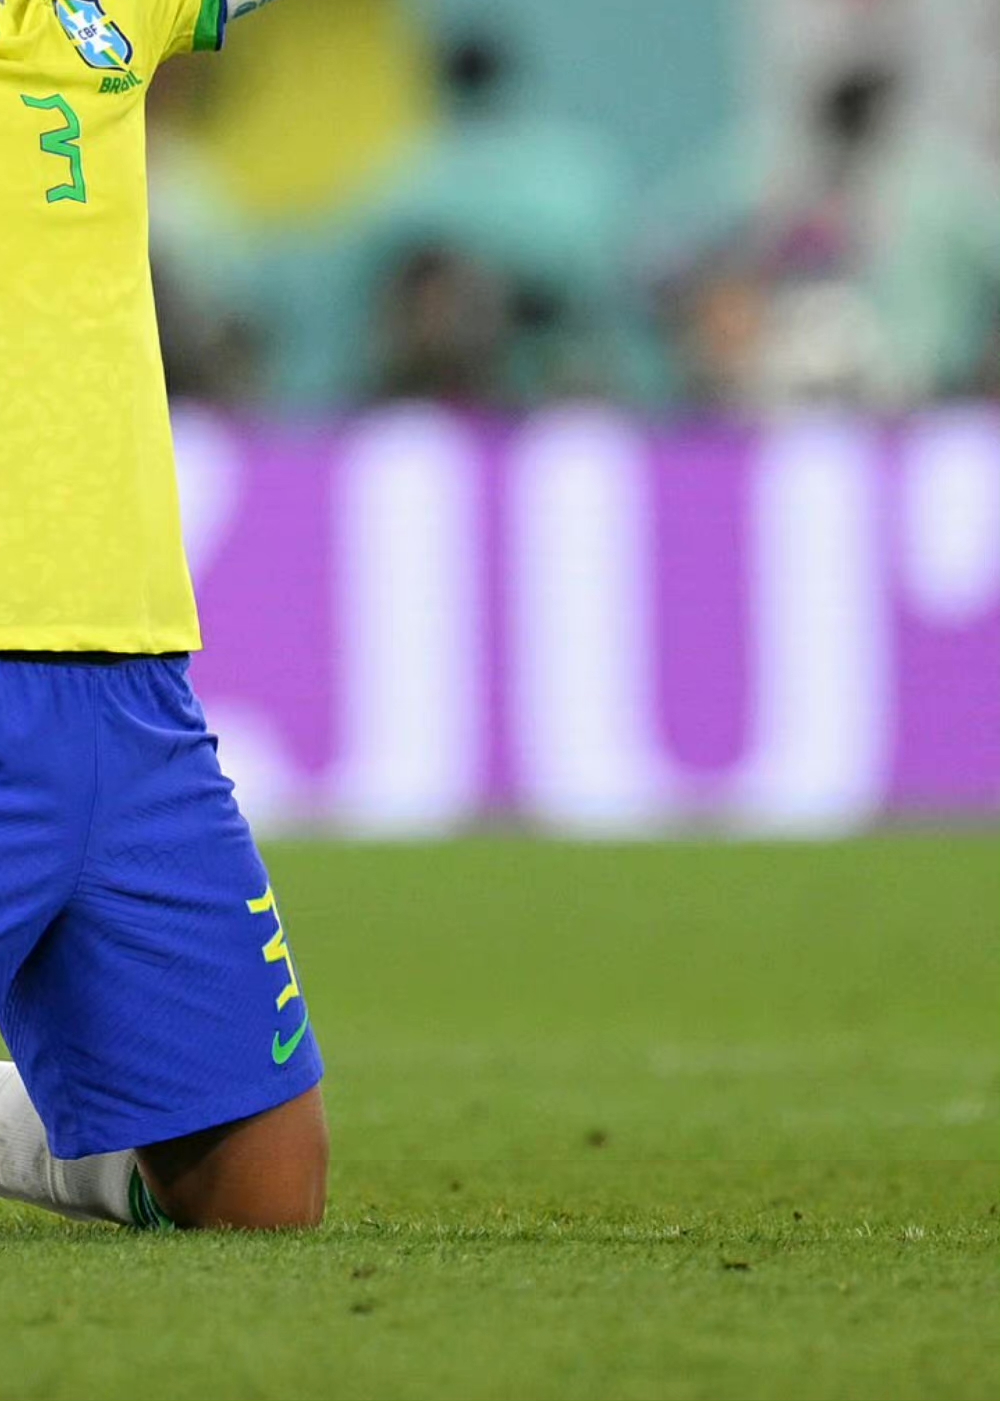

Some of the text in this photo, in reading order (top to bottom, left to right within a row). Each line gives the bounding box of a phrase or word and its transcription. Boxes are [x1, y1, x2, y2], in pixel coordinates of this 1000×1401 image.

[77, 24, 98, 42] CBF
[98, 70, 143, 94] BRAIL
[20, 93, 87, 204] 3
[245, 881, 300, 1012] 3
